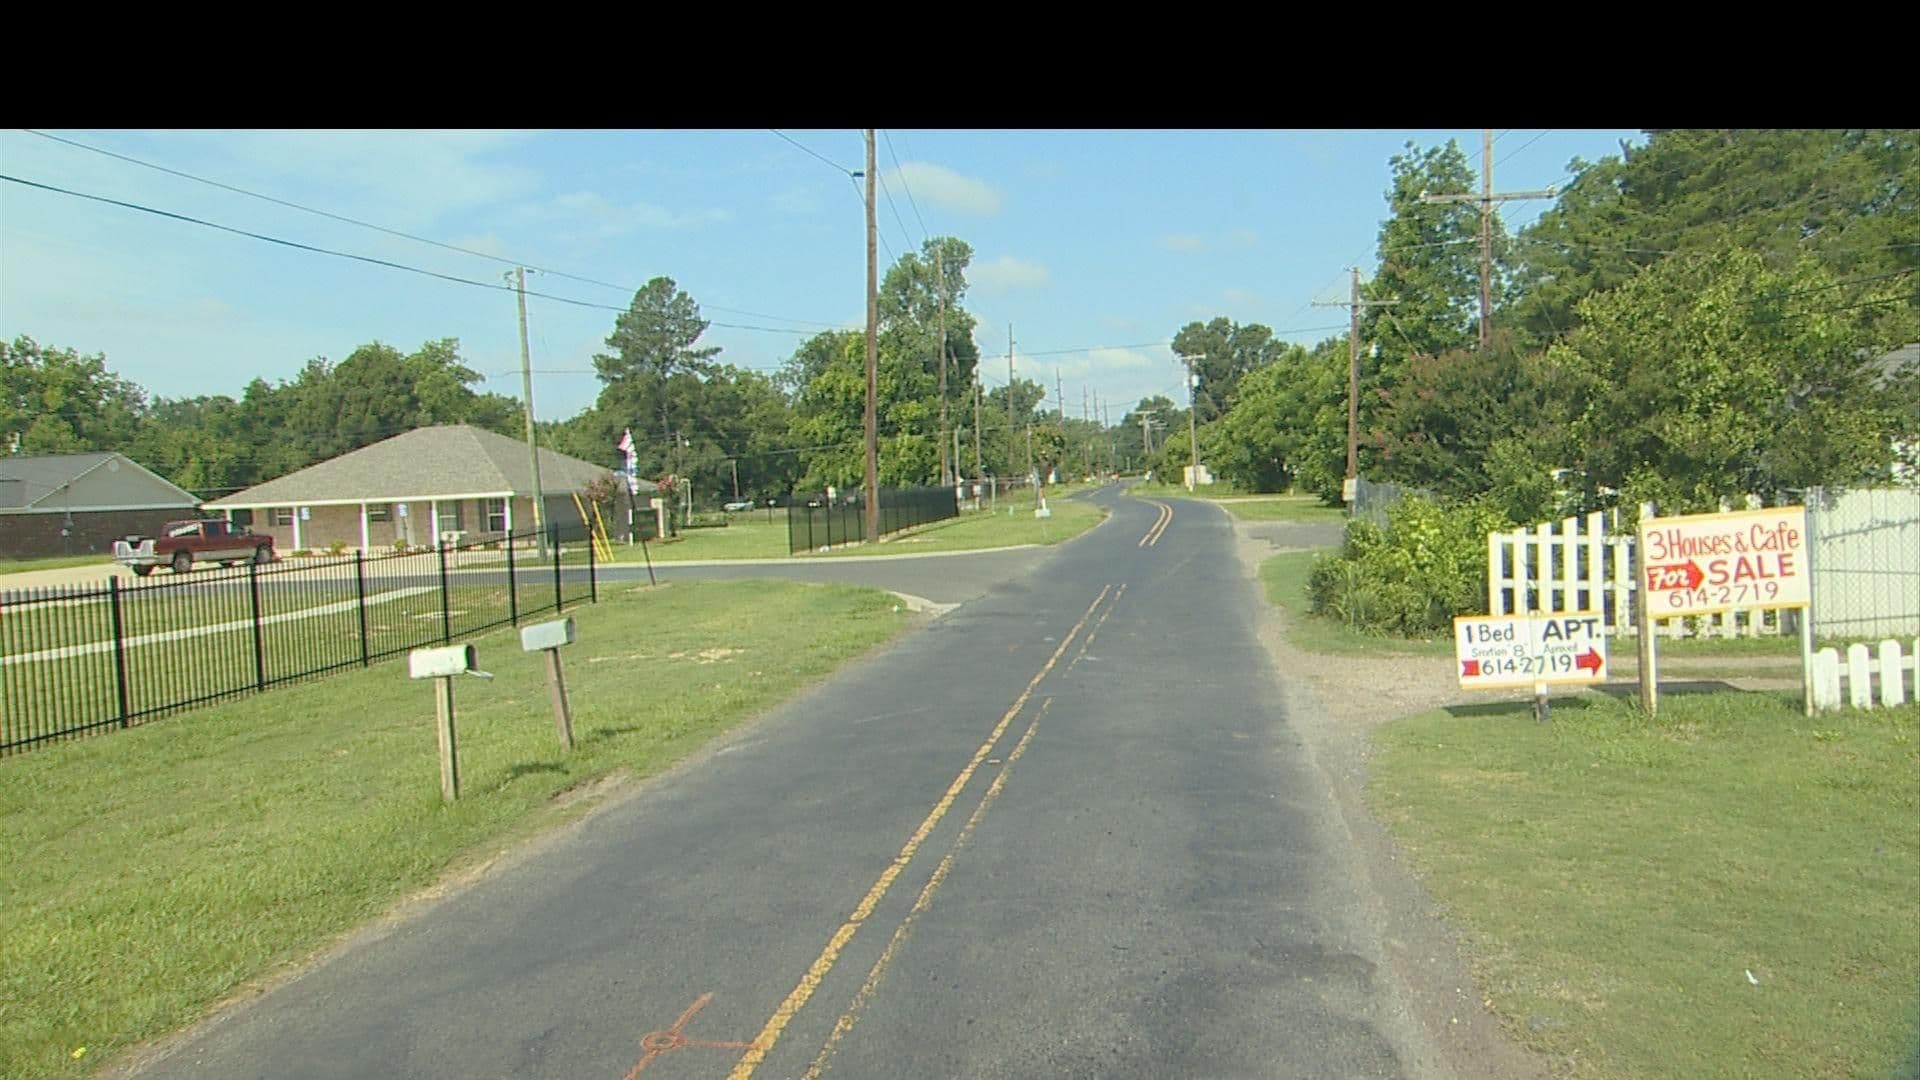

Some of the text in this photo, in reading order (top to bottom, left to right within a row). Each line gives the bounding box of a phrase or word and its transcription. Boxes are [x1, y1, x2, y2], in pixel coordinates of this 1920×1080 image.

[1647, 521, 1800, 560] 3 Houses & Cafe
[1708, 553, 1795, 585] SALE
[1669, 581, 1779, 608] 614-2719
[1466, 618, 1602, 643] 1 Bed APT.
[1482, 654, 1572, 675] 614-2719
